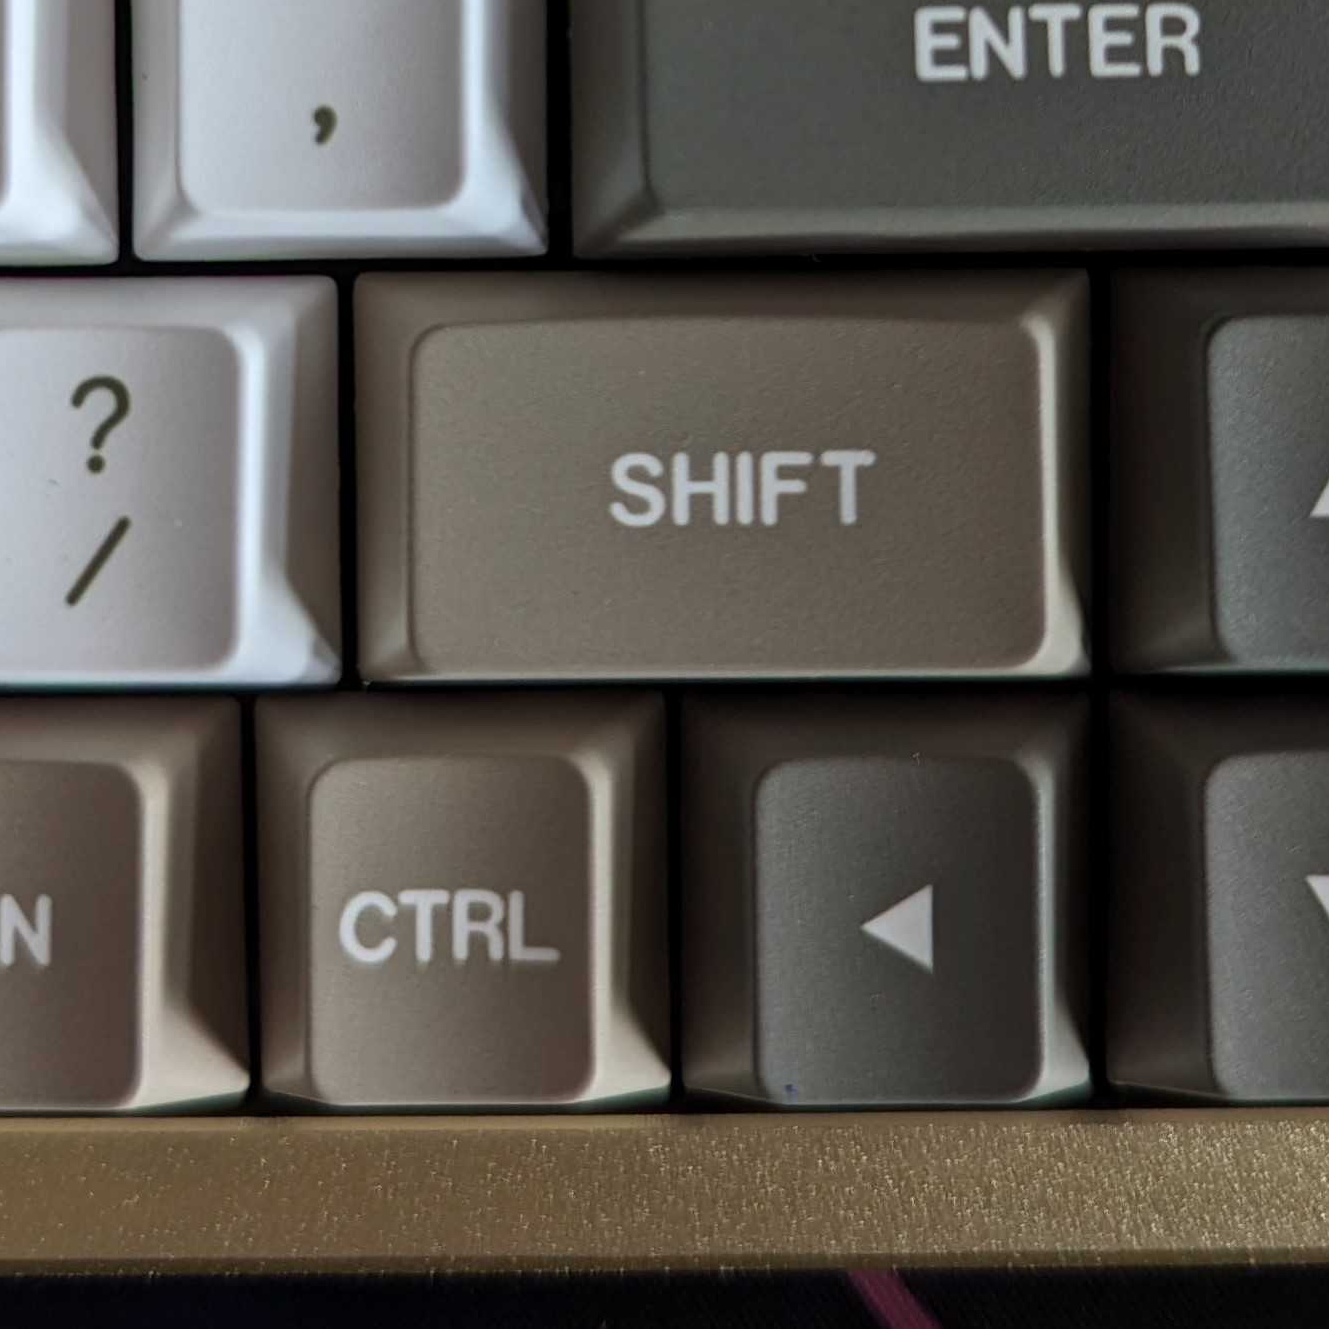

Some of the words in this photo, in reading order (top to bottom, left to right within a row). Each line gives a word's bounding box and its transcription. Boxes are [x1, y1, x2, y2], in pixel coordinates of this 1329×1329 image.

[913, 2, 1201, 82] ENTER
[70, 375, 131, 475] ?
[608, 449, 876, 528] SHIFT
[64, 515, 132, 607] /
[337, 888, 561, 970] CTRL
